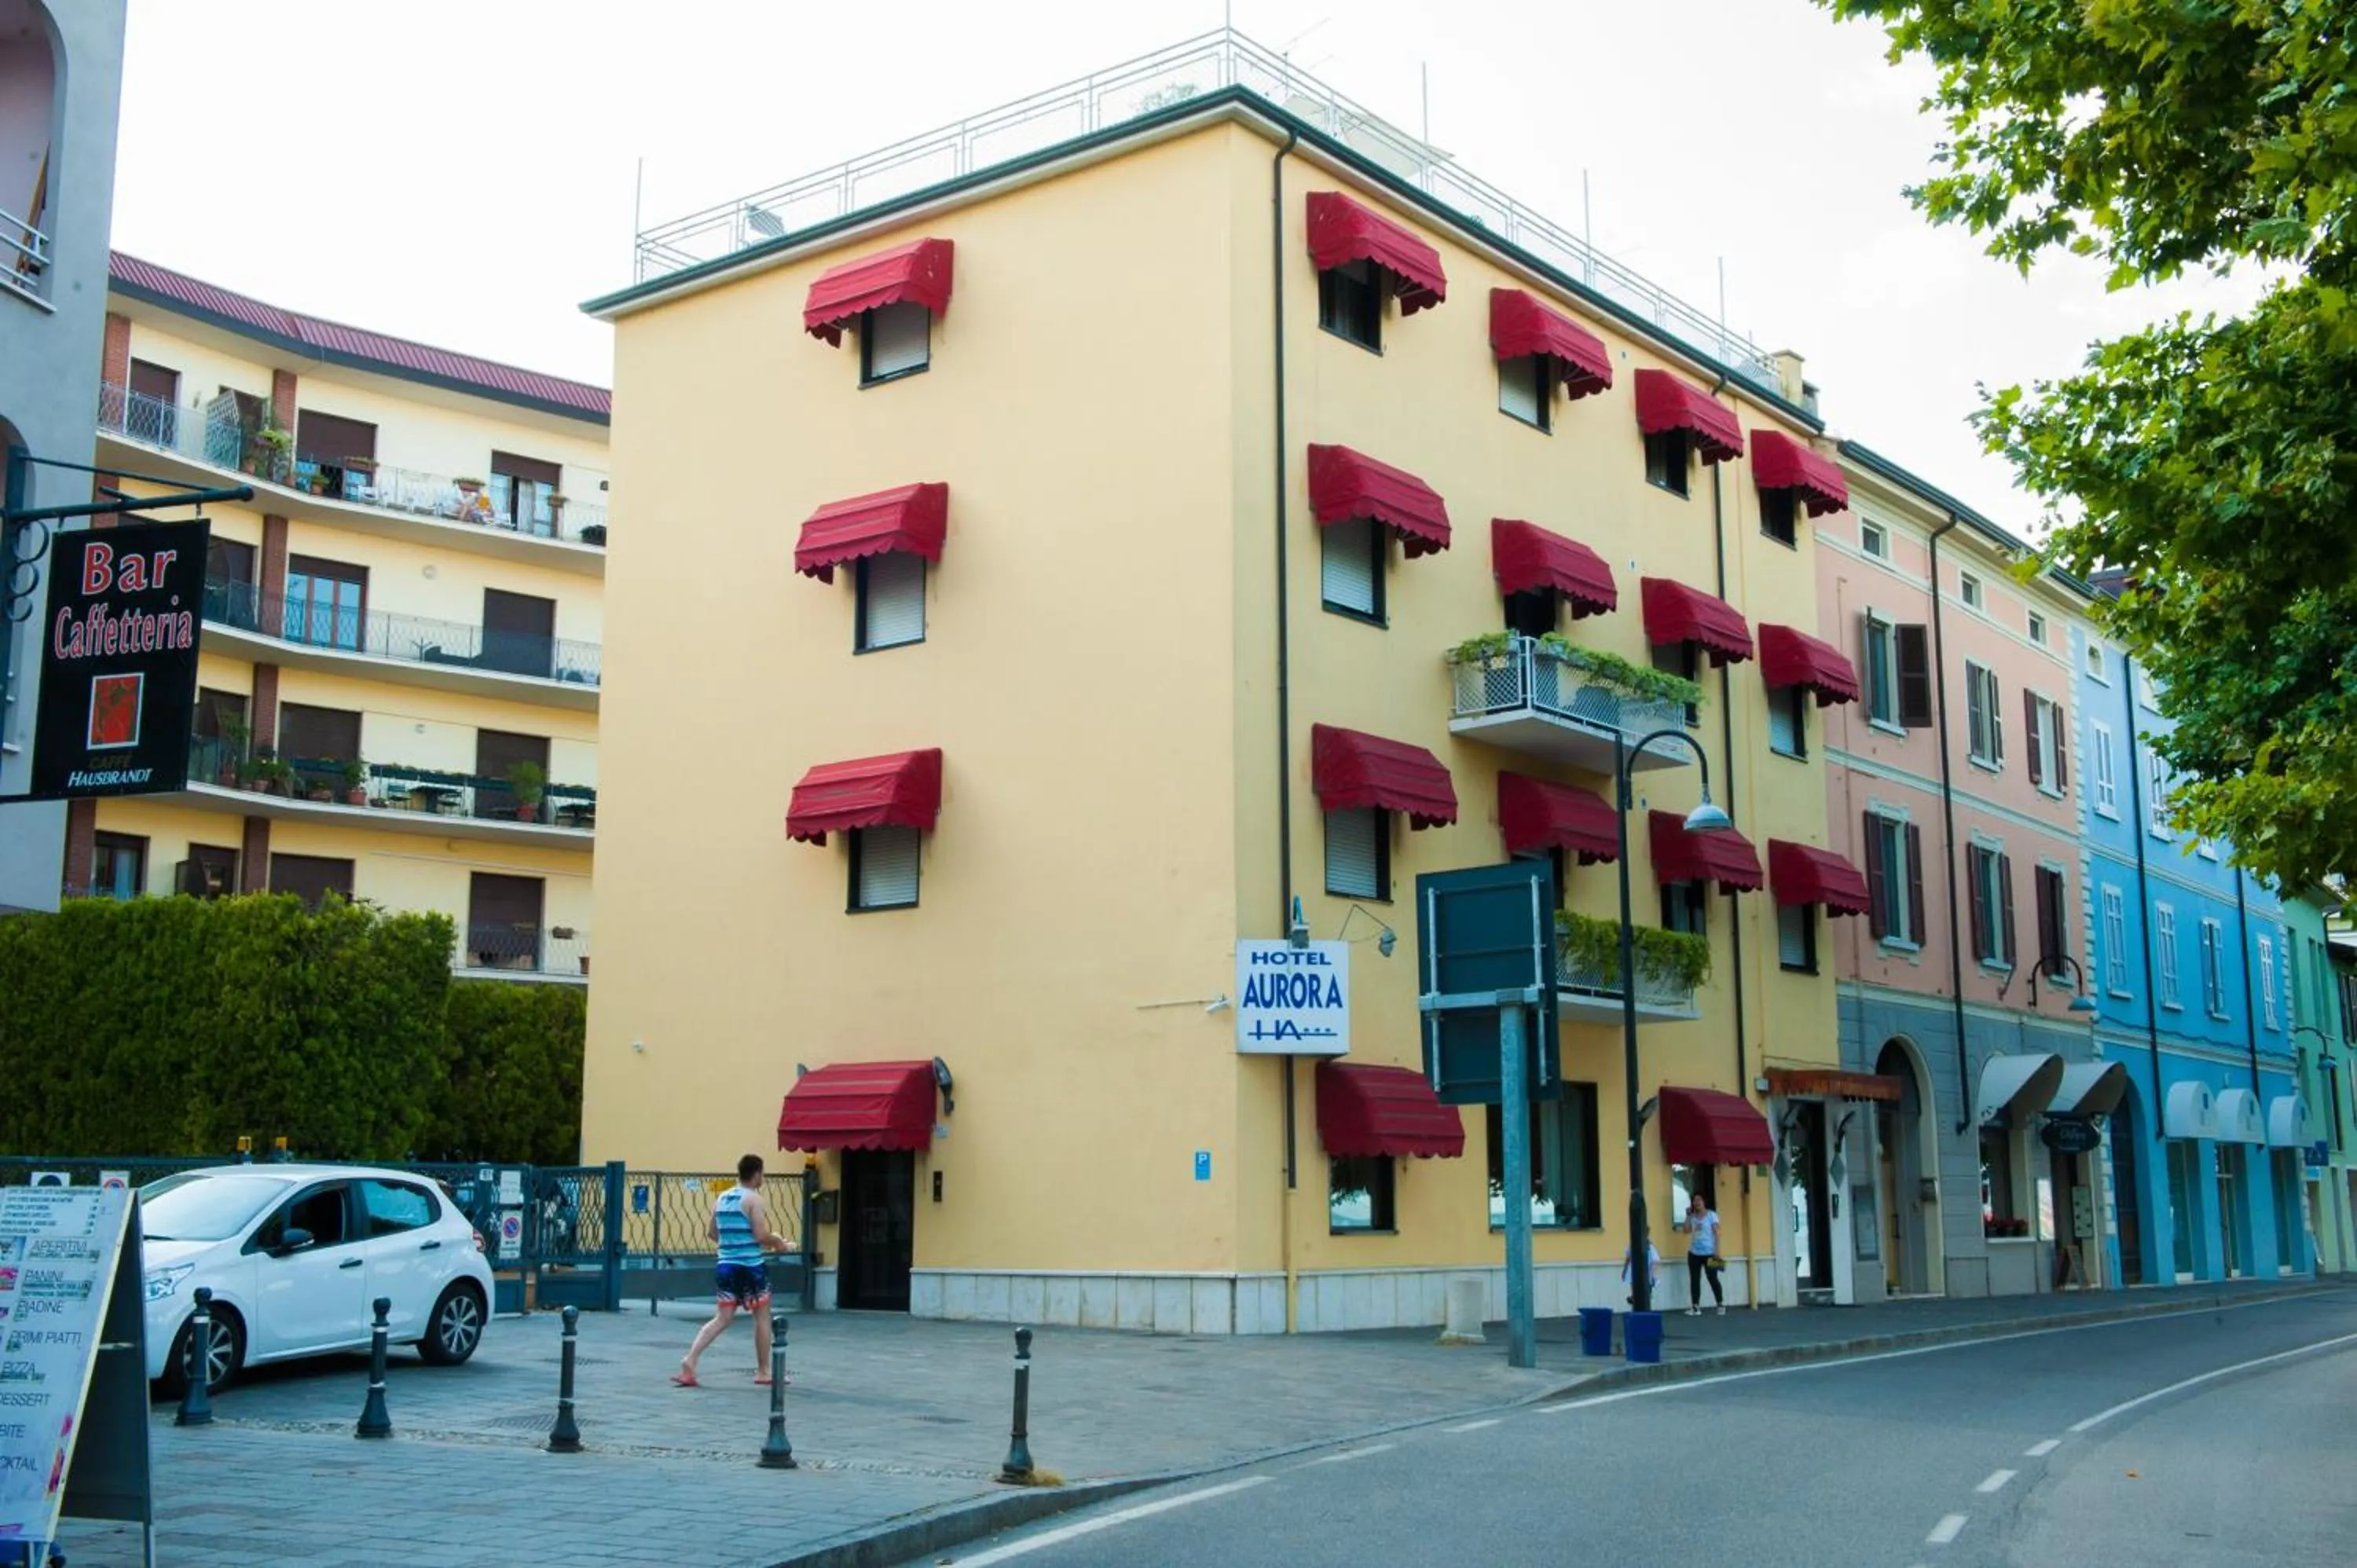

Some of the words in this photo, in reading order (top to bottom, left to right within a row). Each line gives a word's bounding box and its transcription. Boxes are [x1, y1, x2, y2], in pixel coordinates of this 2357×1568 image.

[82, 542, 177, 595] Bar
[54, 595, 193, 659] Caffetteria
[68, 768, 153, 787] HAUSBRANDT
[1252, 952, 1332, 965] HOTEL
[1242, 973, 1343, 1009] AURORA
[24, 1269, 64, 1282] PANINI
[45, 1332, 82, 1344] PIATTI
